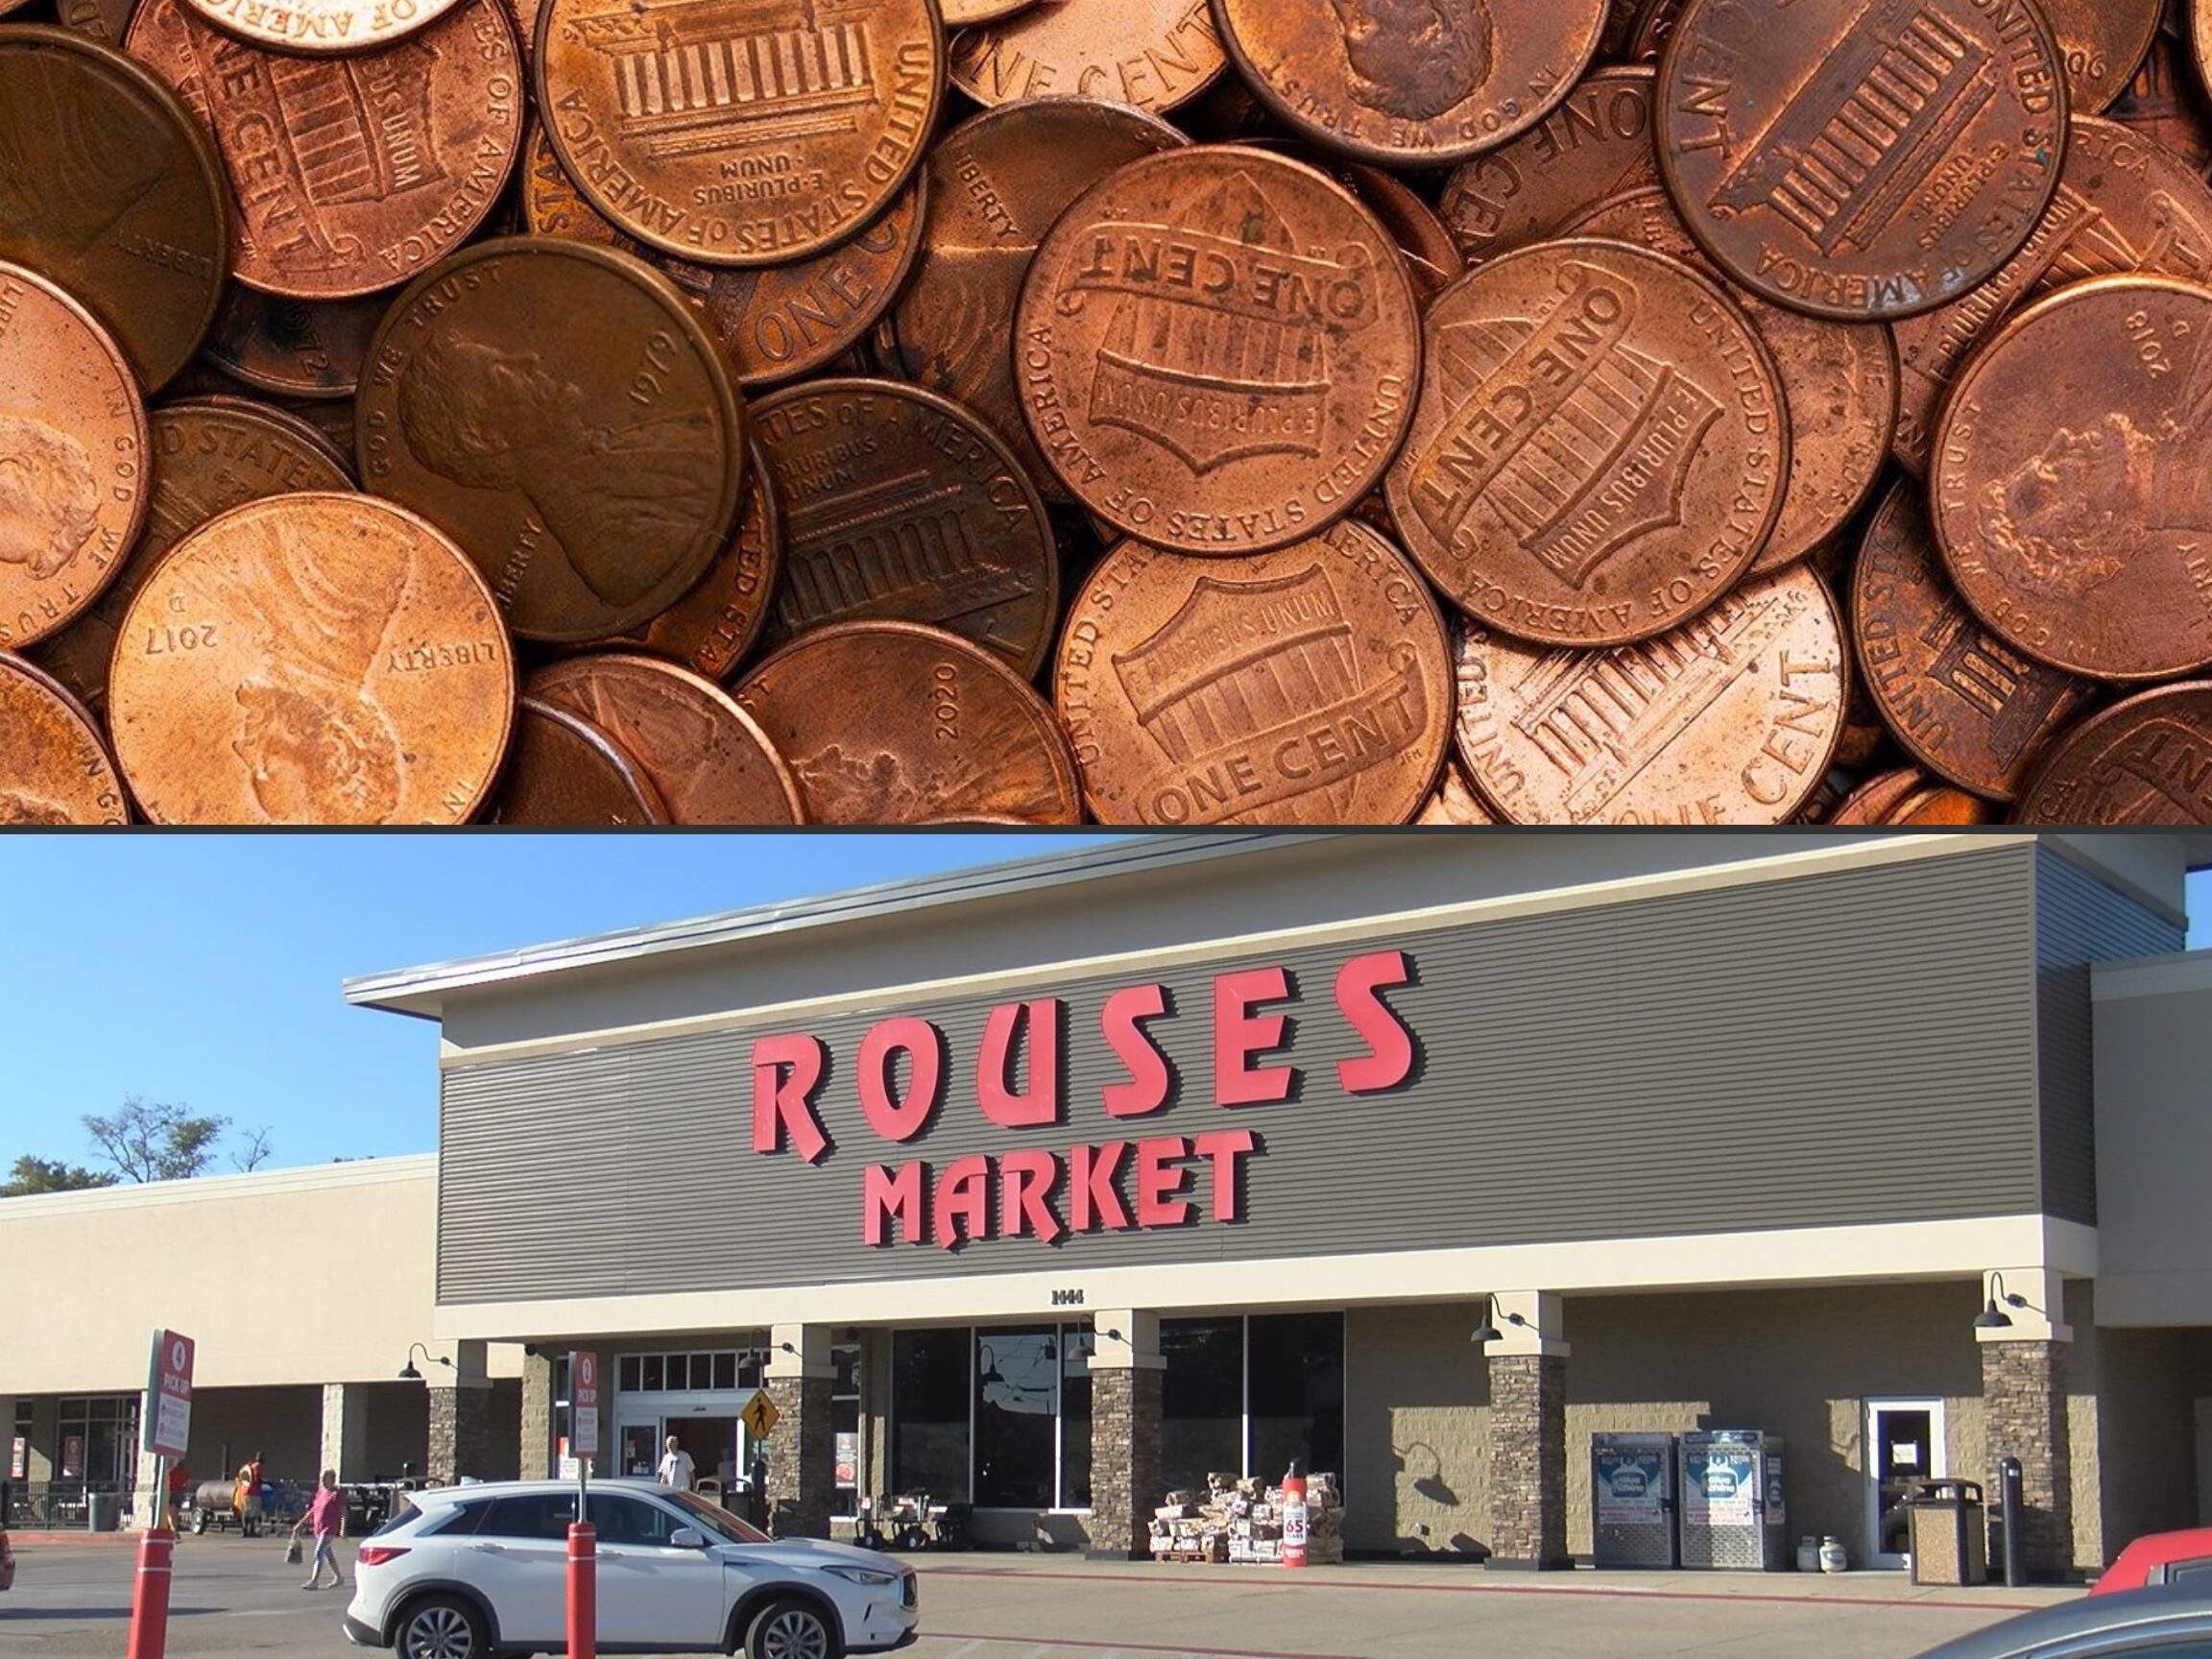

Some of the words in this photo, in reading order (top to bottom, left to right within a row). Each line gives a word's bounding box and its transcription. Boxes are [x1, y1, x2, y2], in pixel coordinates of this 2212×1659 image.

[487, 77, 512, 124] OF
[2066, 51, 2106, 80] 06
[864, 41, 930, 185] UNITED
[1262, 63, 1361, 140] TRUST
[1457, 99, 1523, 141] GOD
[384, 112, 420, 187] UNUM
[557, 87, 685, 234] AMERICA
[721, 154, 792, 177] UNUM
[1391, 128, 1436, 149] WE
[233, 112, 313, 255] CENT
[379, 135, 506, 271] AMERICA
[735, 182, 868, 254] STATES
[687, 221, 726, 248] OF
[1079, 234, 1238, 296] CENT
[405, 261, 502, 331] TRUST
[755, 266, 874, 361] ONE
[1254, 267, 1364, 320] ONE
[1529, 286, 1623, 387] ONE
[2126, 310, 2171, 379] 2018
[2172, 321, 2190, 338] D
[1689, 300, 1769, 435] UNITED
[1026, 325, 1106, 486] AMERICA
[1313, 374, 1405, 505] UNITED
[113, 436, 135, 501] GOD
[198, 421, 328, 491] STATE
[1422, 384, 1534, 514] CENT
[1600, 404, 1690, 514] PLURIBUS
[1944, 399, 1981, 511] TRUST
[1106, 487, 1156, 525] OF
[1167, 499, 1307, 541] STATES
[1542, 508, 1615, 569] UNUM
[1698, 446, 1772, 578] STATES
[88, 527, 120, 570] WE
[0, 583, 79, 641] TRUS
[1262, 589, 1337, 634] UNUM
[1466, 569, 1633, 636] AMERICA
[1650, 578, 1693, 617] OF
[145, 625, 220, 656] 2017
[384, 641, 498, 674] LIBERTY
[934, 662, 957, 741] 2020
[1059, 619, 1101, 766] UNITED
[1864, 618, 1949, 752] UNITED
[1152, 755, 1262, 825] ONE
[1275, 685, 1414, 779] CENT
[1457, 656, 1526, 800] UNITED
[1742, 648, 1830, 806] CENT
[752, 950, 1413, 1164] ROUSES
[864, 1130, 1254, 1249] MARKET
[1051, 1288, 1084, 1306] 1444
[1286, 1519, 1304, 1533] 65
